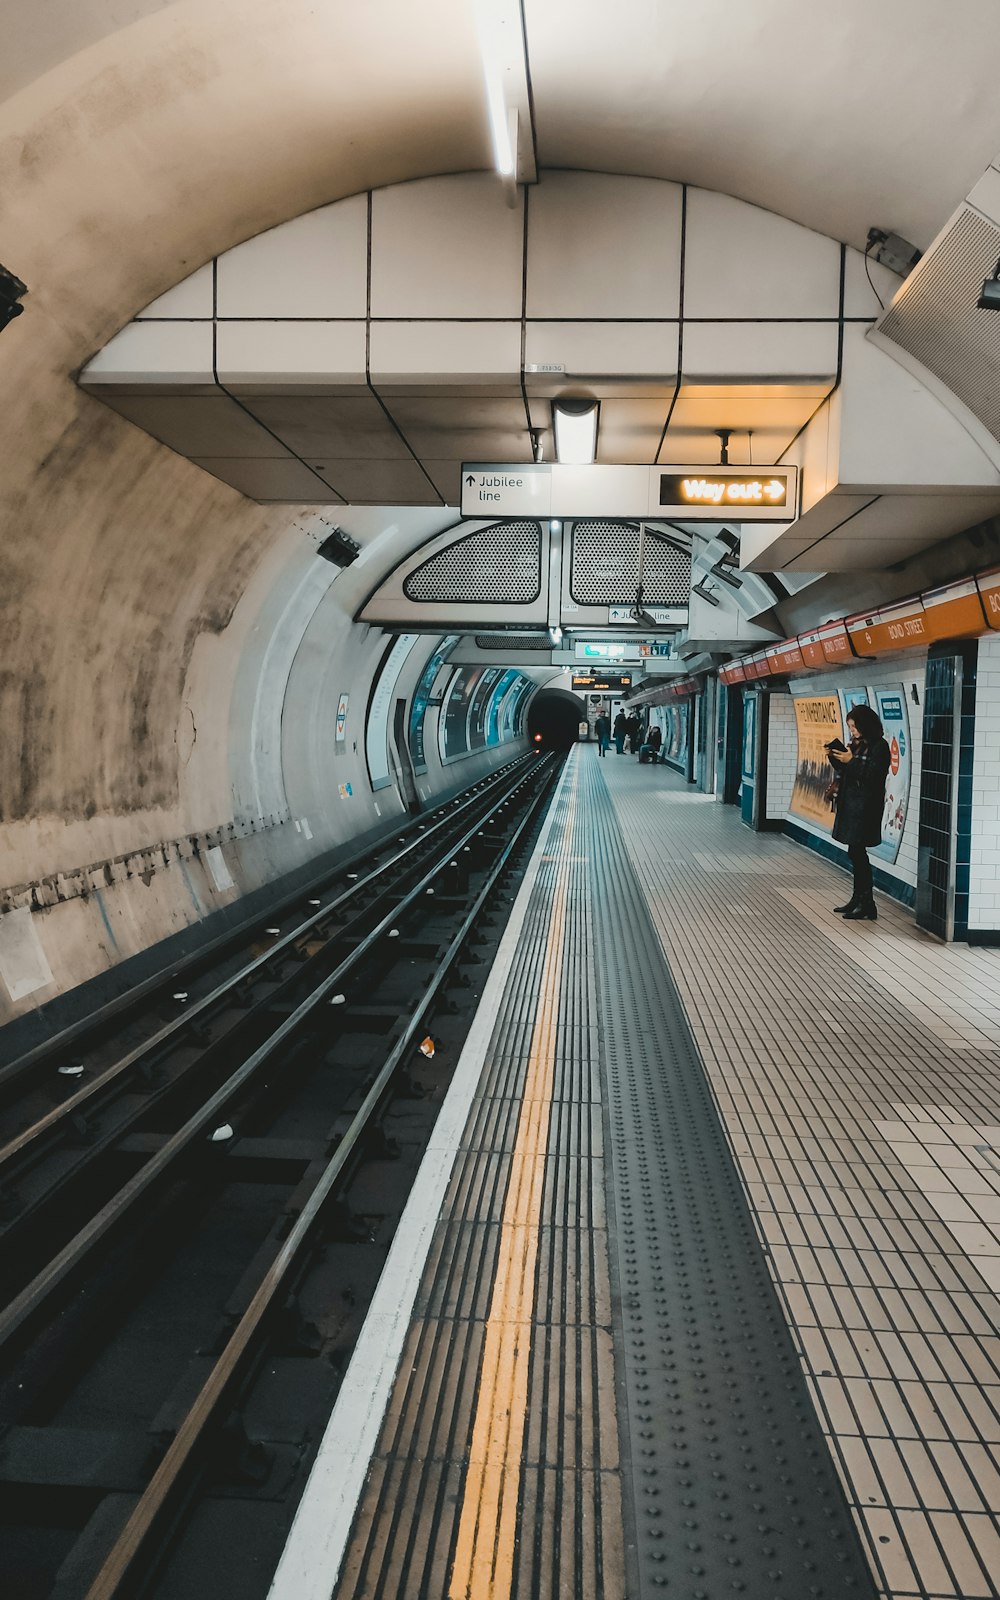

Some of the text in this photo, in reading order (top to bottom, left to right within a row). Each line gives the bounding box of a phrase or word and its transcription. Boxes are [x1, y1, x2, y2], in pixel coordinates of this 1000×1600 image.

[479, 476, 523, 487] Jubilee
[479, 490, 501, 501] line
[682, 479, 763, 502] Way out
[654, 612, 671, 620] line
[887, 618, 926, 640] BOND STREET
